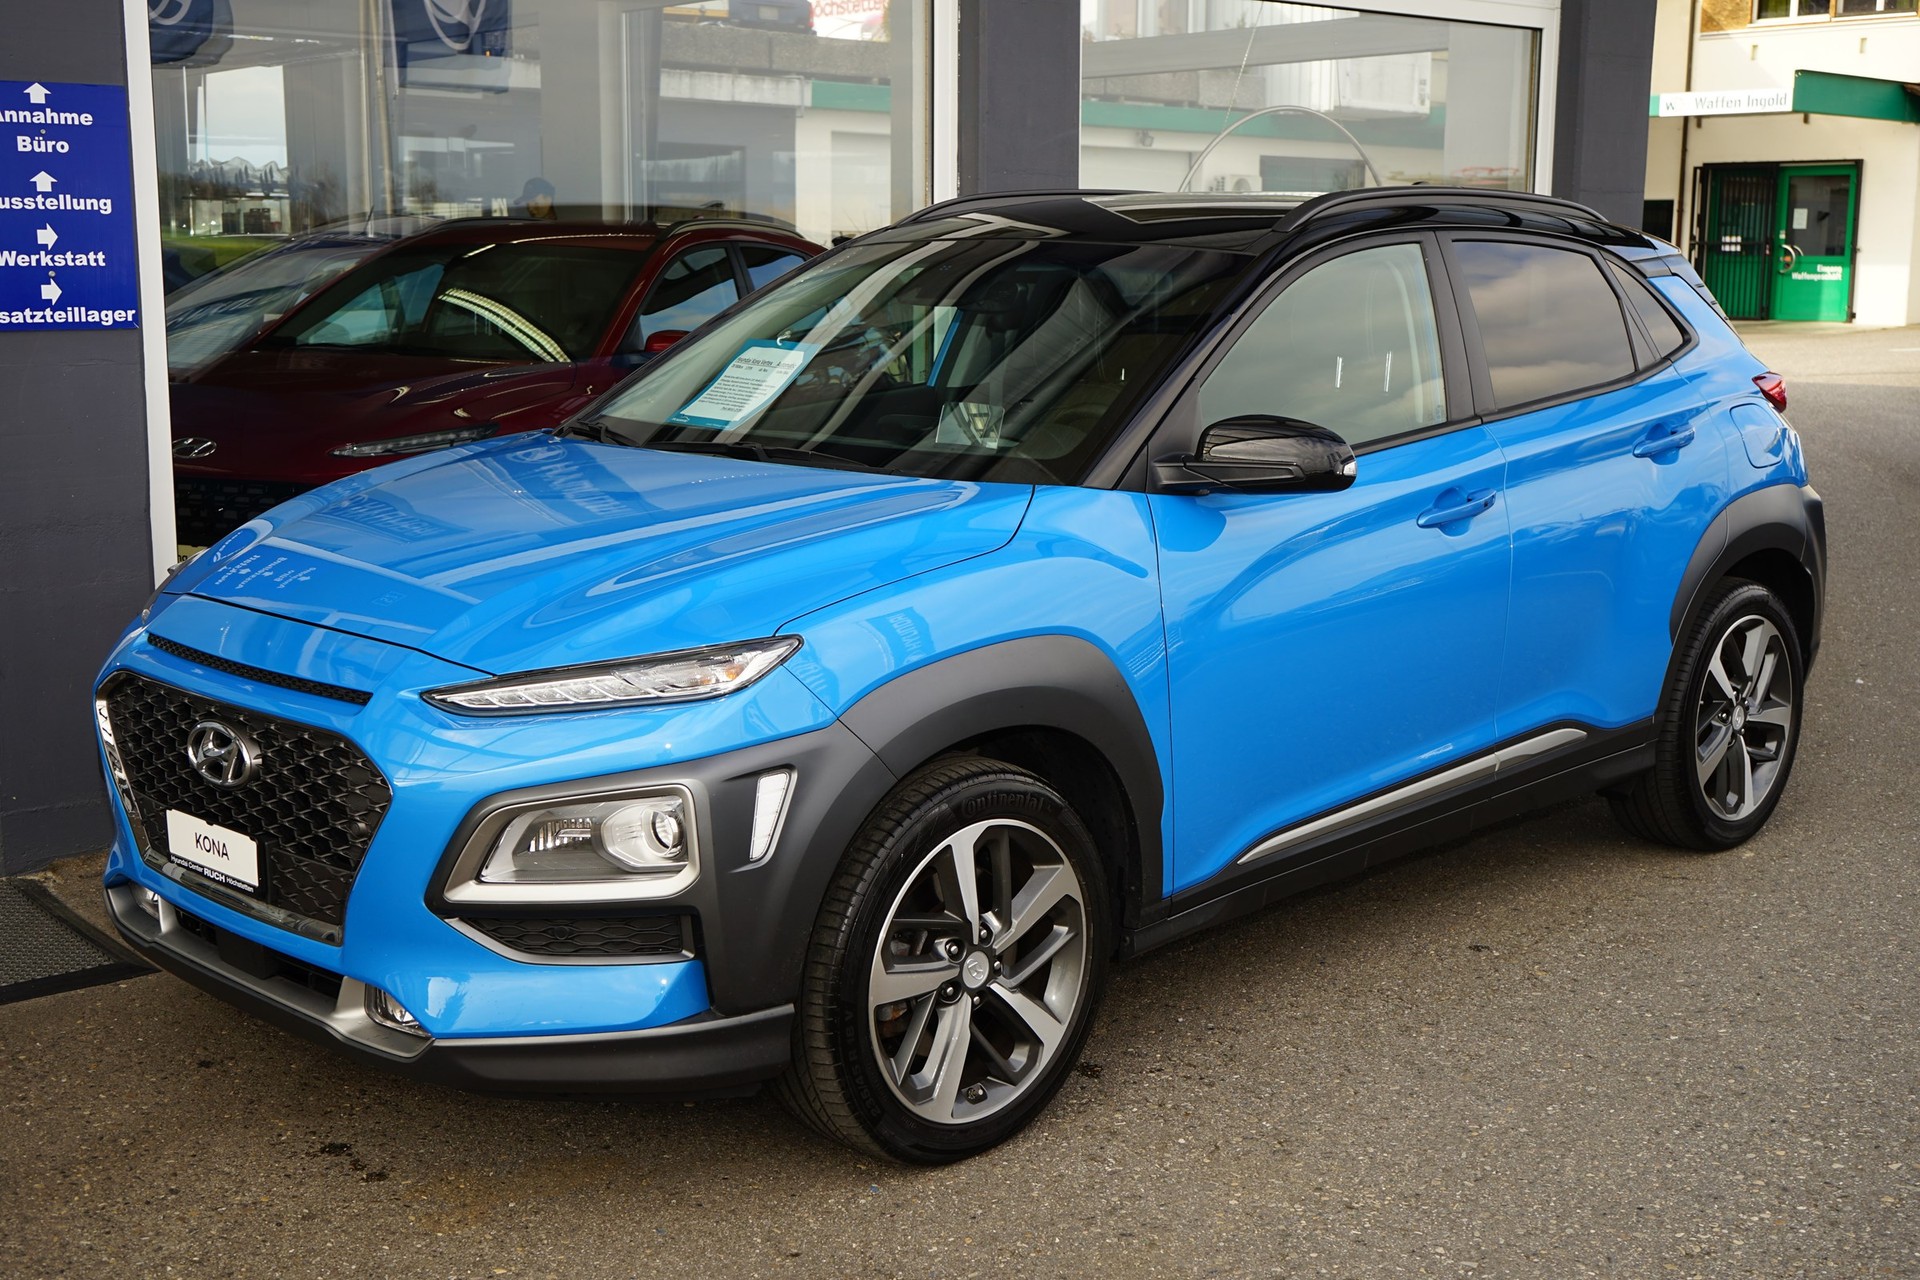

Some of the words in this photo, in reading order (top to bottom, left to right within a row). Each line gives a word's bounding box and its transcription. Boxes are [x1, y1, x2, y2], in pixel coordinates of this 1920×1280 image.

[1695, 97, 1741, 110] Waffen
[1747, 92, 1788, 110] Ingold
[0, 108, 93, 125] nnahme
[16, 136, 69, 153] Büro
[0, 251, 106, 267] Werkstatt
[961, 790, 1044, 818] Continental
[195, 832, 230, 861] KONA
[170, 855, 188, 867] Hyundai
[188, 861, 203, 873] Center
[203, 867, 225, 883] RUCH
[226, 876, 254, 893] Höchstetten
